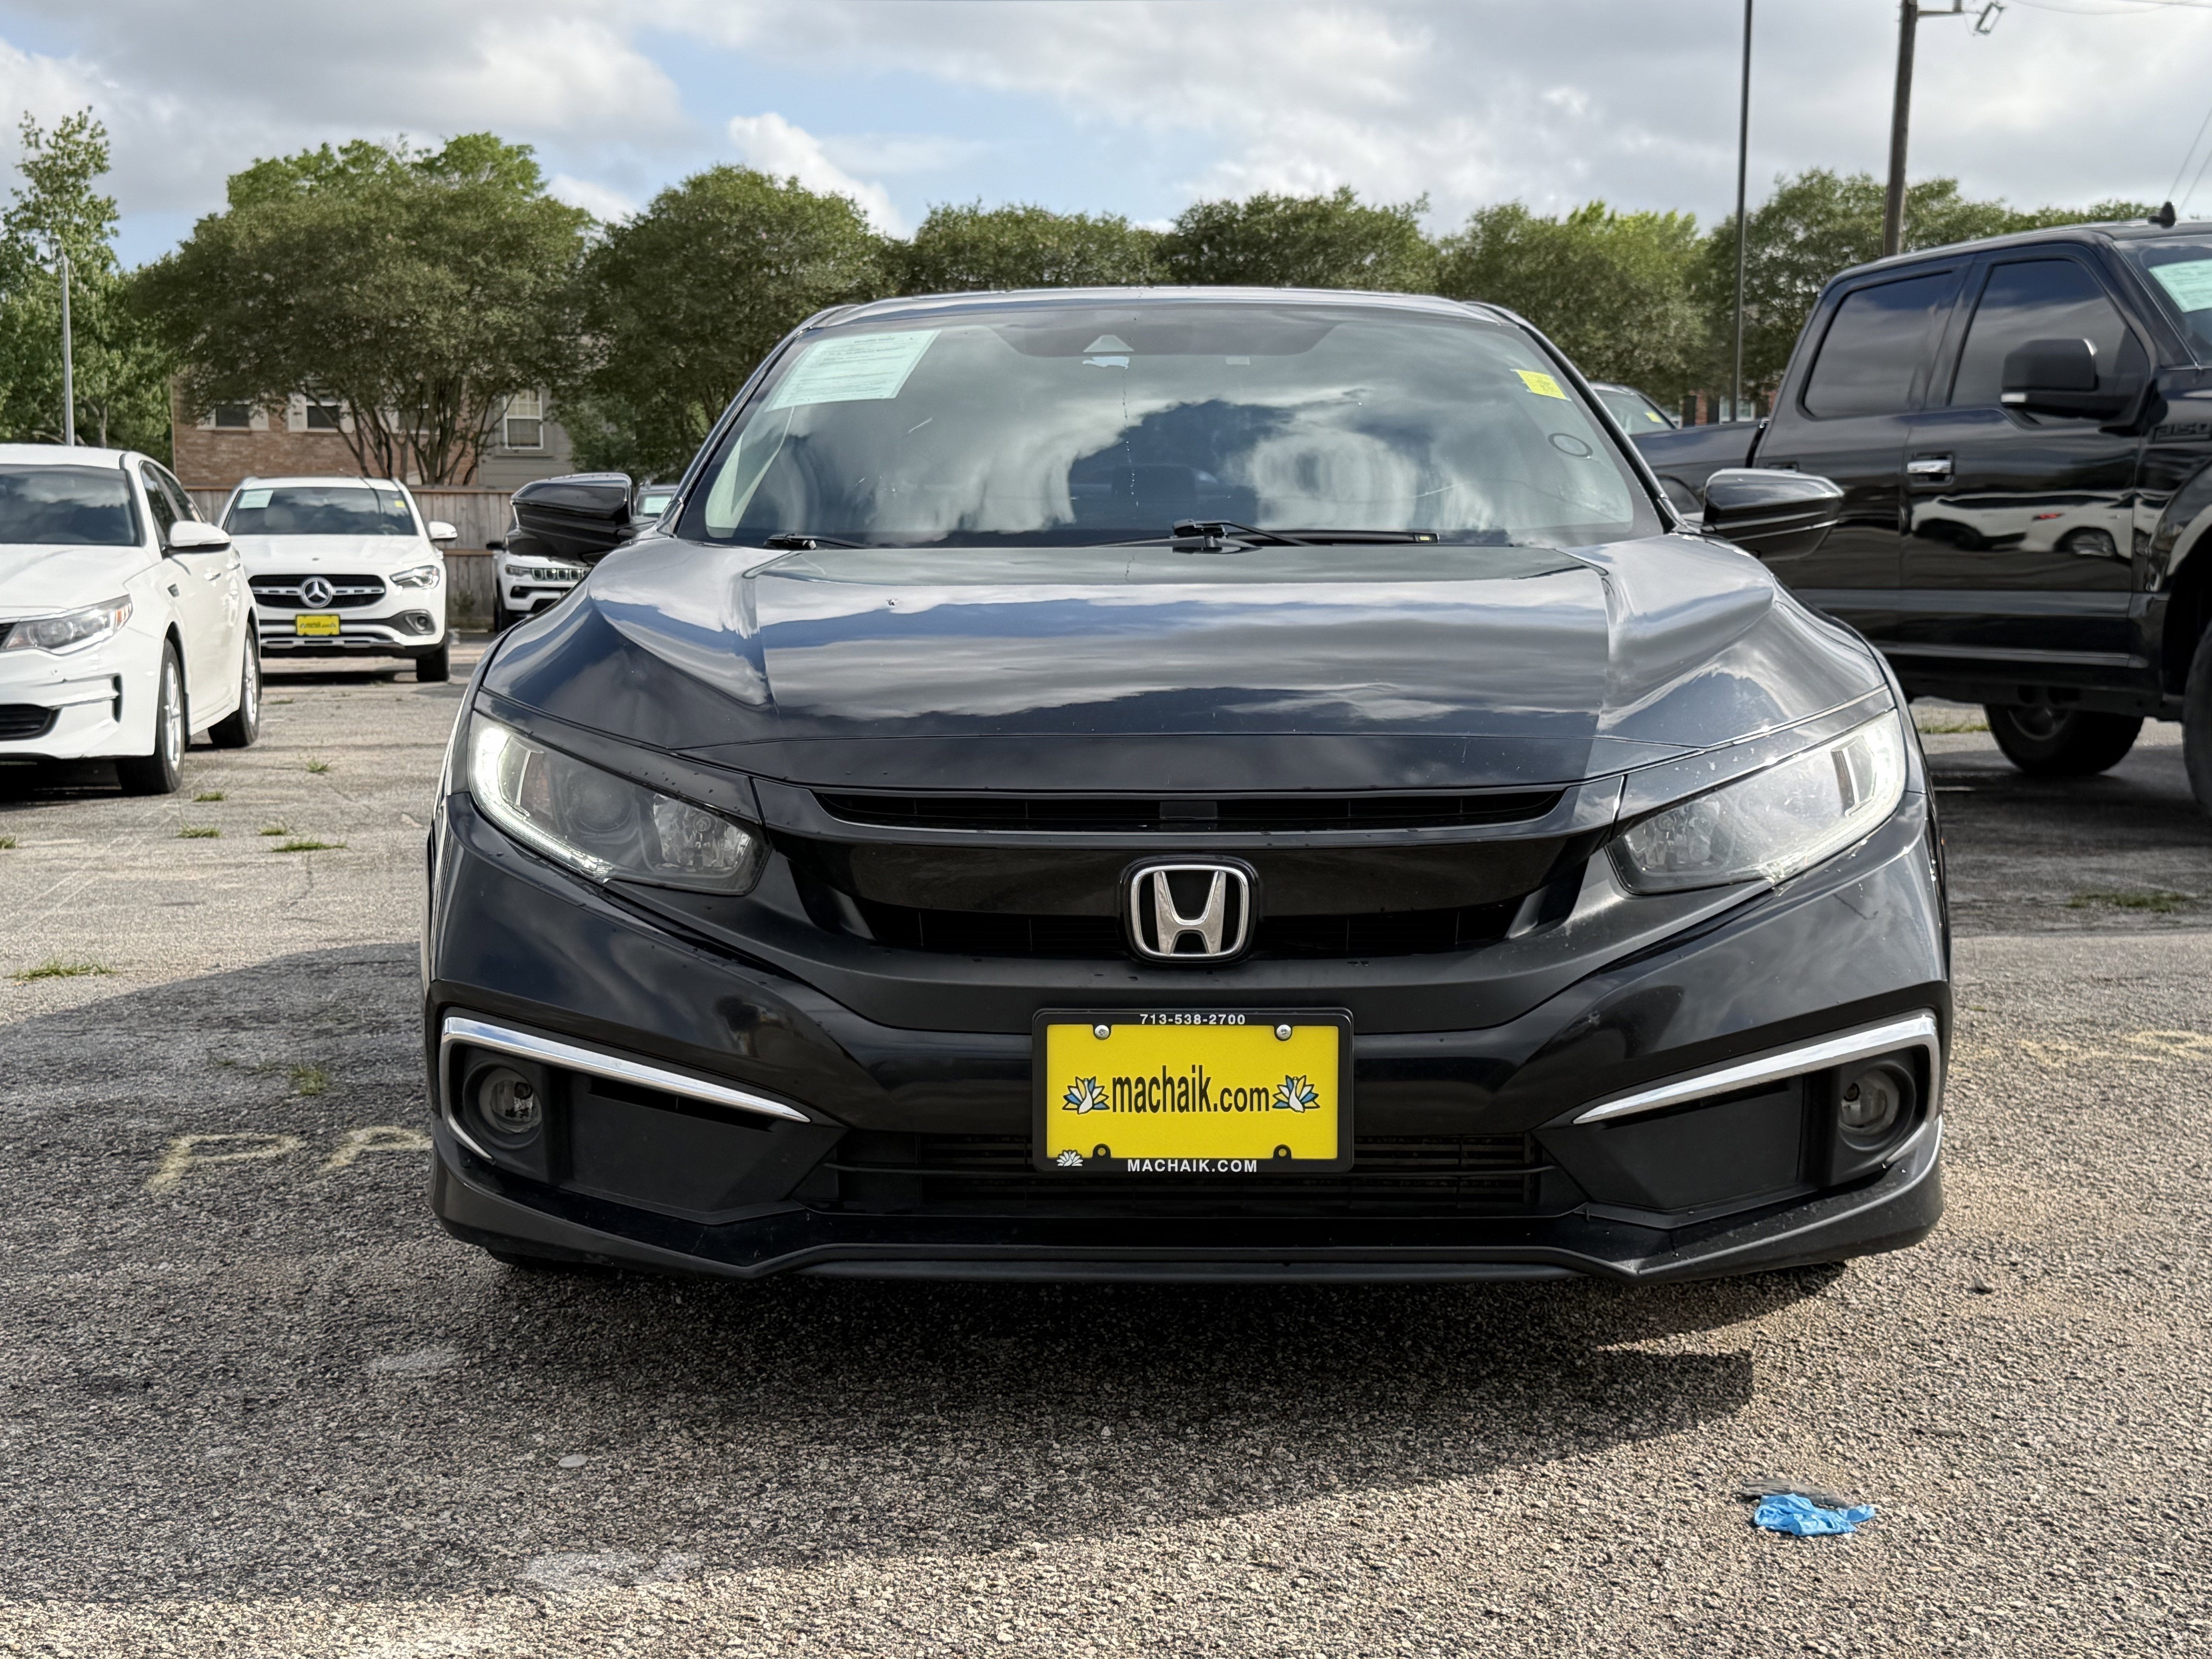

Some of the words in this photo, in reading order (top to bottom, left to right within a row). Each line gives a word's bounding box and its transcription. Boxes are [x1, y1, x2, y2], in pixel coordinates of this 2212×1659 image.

[1139, 1013, 1246, 1025] 713-538-2700
[1112, 1064, 1270, 1114] machaik.com
[1127, 1159, 1257, 1173] MACHAIK.COM
